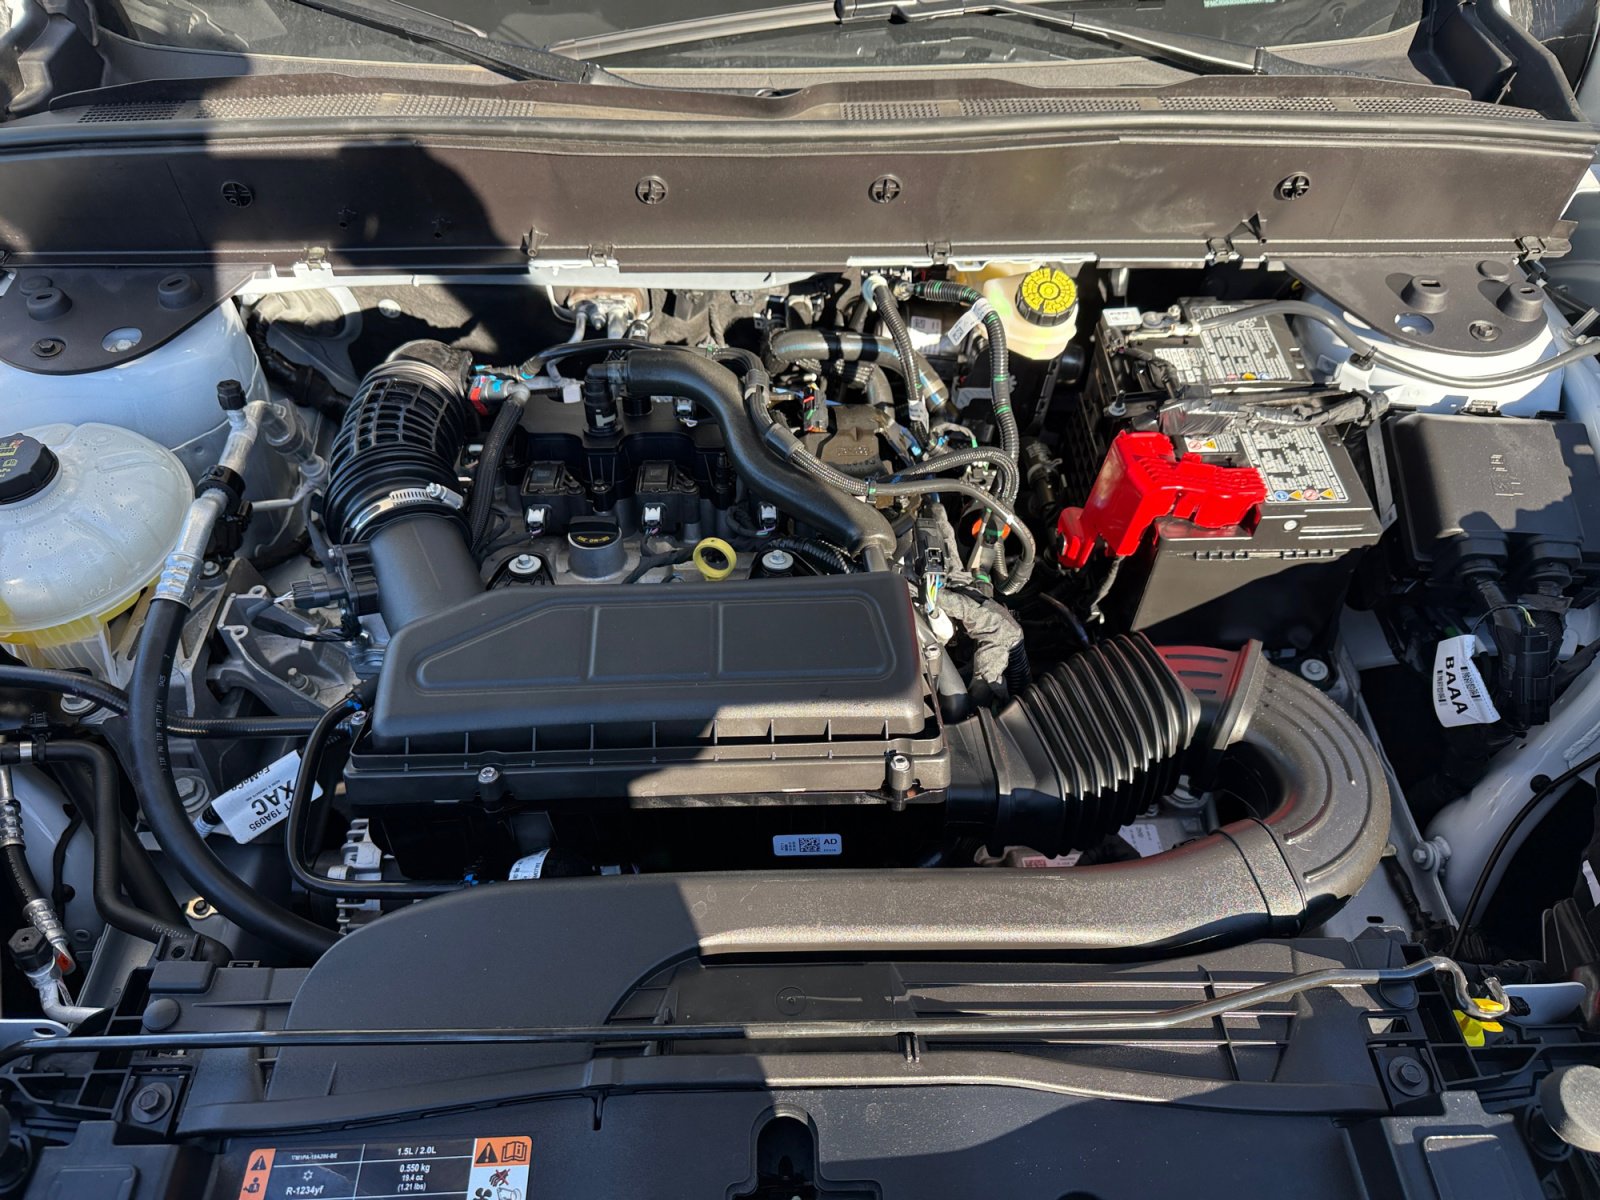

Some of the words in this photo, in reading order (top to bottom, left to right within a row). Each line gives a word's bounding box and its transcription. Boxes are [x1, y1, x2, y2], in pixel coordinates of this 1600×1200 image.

[1445, 656, 1469, 715] BAAA
[251, 780, 294, 816] XAC
[248, 808, 283, 832] 19A095
[397, 1147, 414, 1155] 1.5L
[419, 1146, 437, 1154] 2.0L
[399, 1164, 420, 1173] 0.550
[420, 1163, 431, 1173] kg
[401, 1174, 415, 1182] 19.4
[285, 1184, 325, 1196] R-1234yf
[397, 1183, 413, 1192] (1.21
[414, 1183, 427, 1191] lbs)
